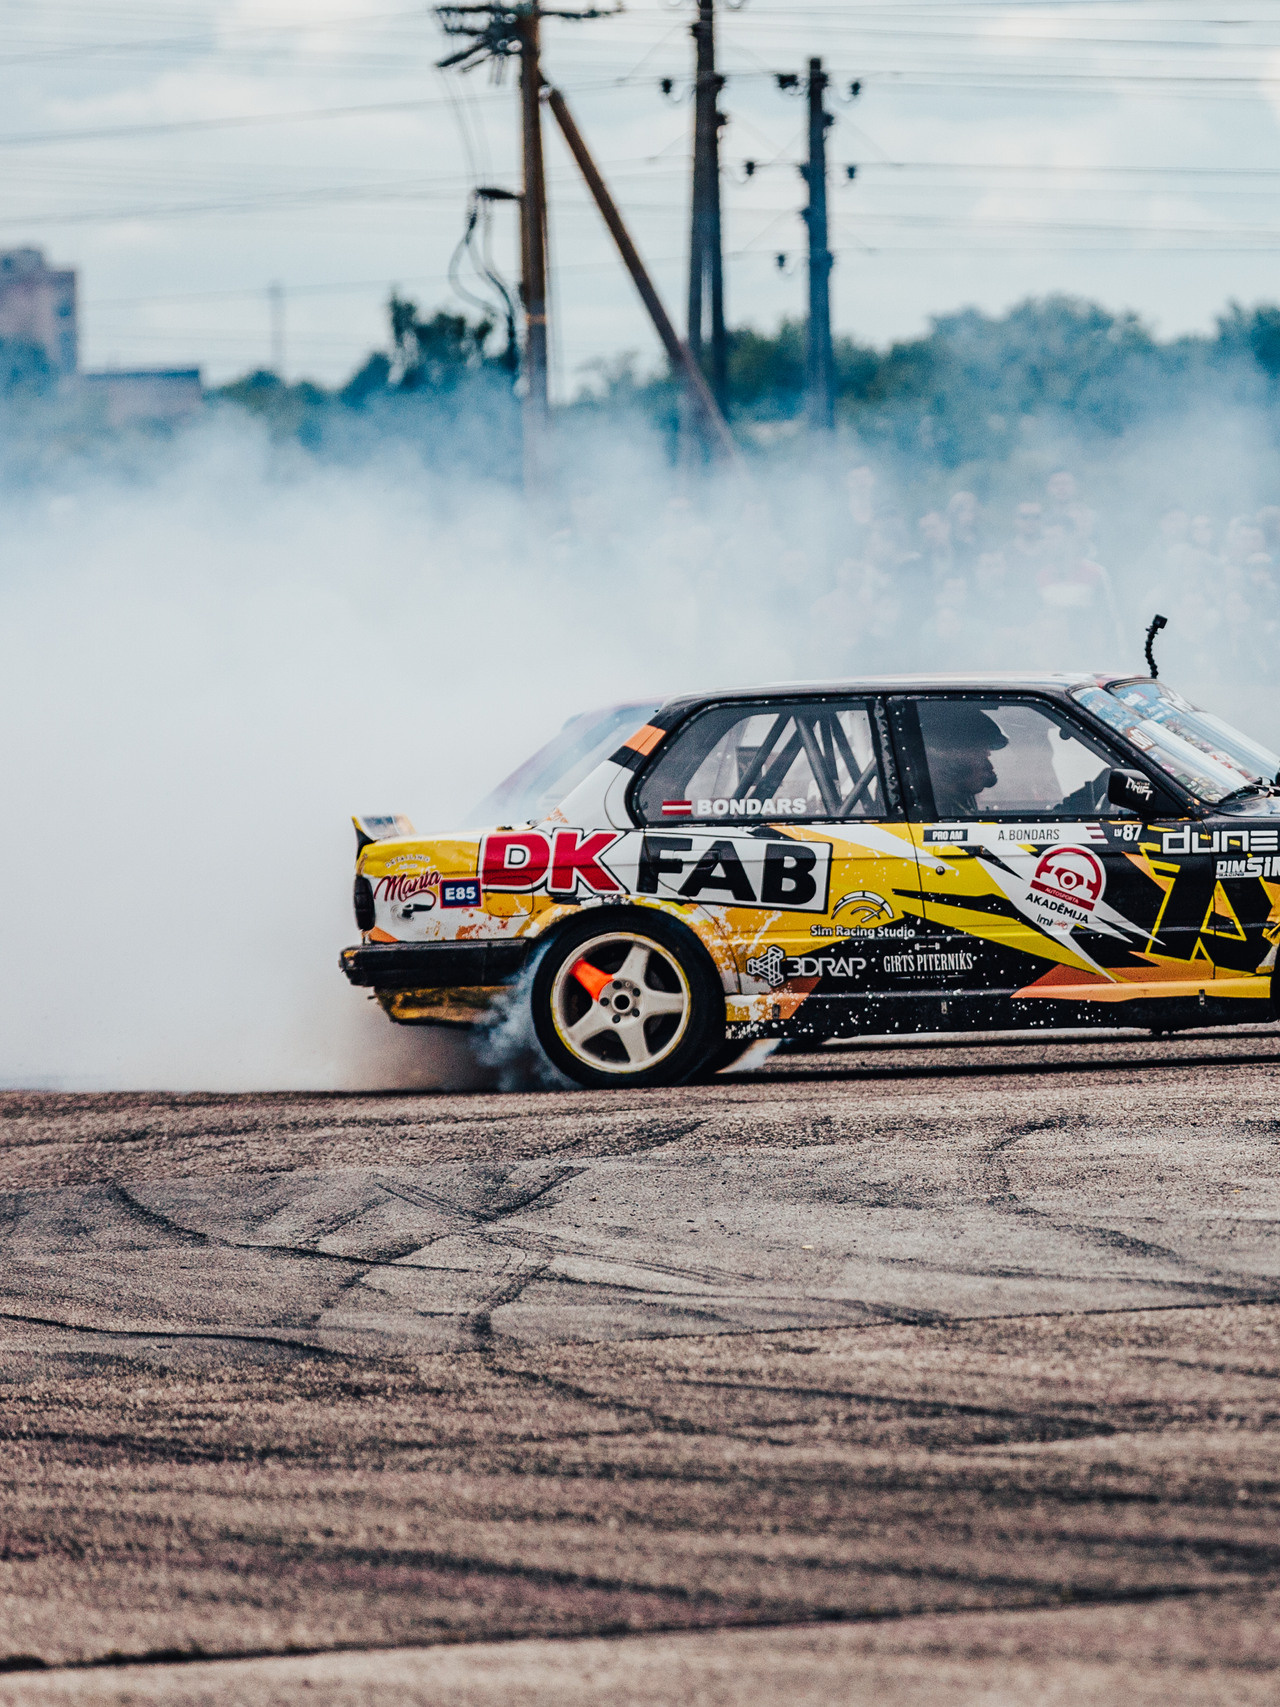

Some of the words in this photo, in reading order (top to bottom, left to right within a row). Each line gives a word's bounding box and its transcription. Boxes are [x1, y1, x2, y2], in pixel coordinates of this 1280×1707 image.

[697, 798, 807, 816] BONDARS
[932, 830, 949, 841] PRO
[950, 830, 964, 841] AM
[1122, 825, 1143, 841] 87
[480, 827, 628, 896] DK
[636, 836, 818, 905] FAB
[373, 870, 441, 903] Mania
[445, 887, 476, 901] E85
[1045, 887, 1080, 904] AUTOSPORTA
[1025, 893, 1089, 924] AKADĒMIJA
[811, 925, 832, 936] Sim
[836, 926, 875, 939] Racing
[877, 925, 916, 938] Studio
[787, 957, 867, 977] 3DRAP
